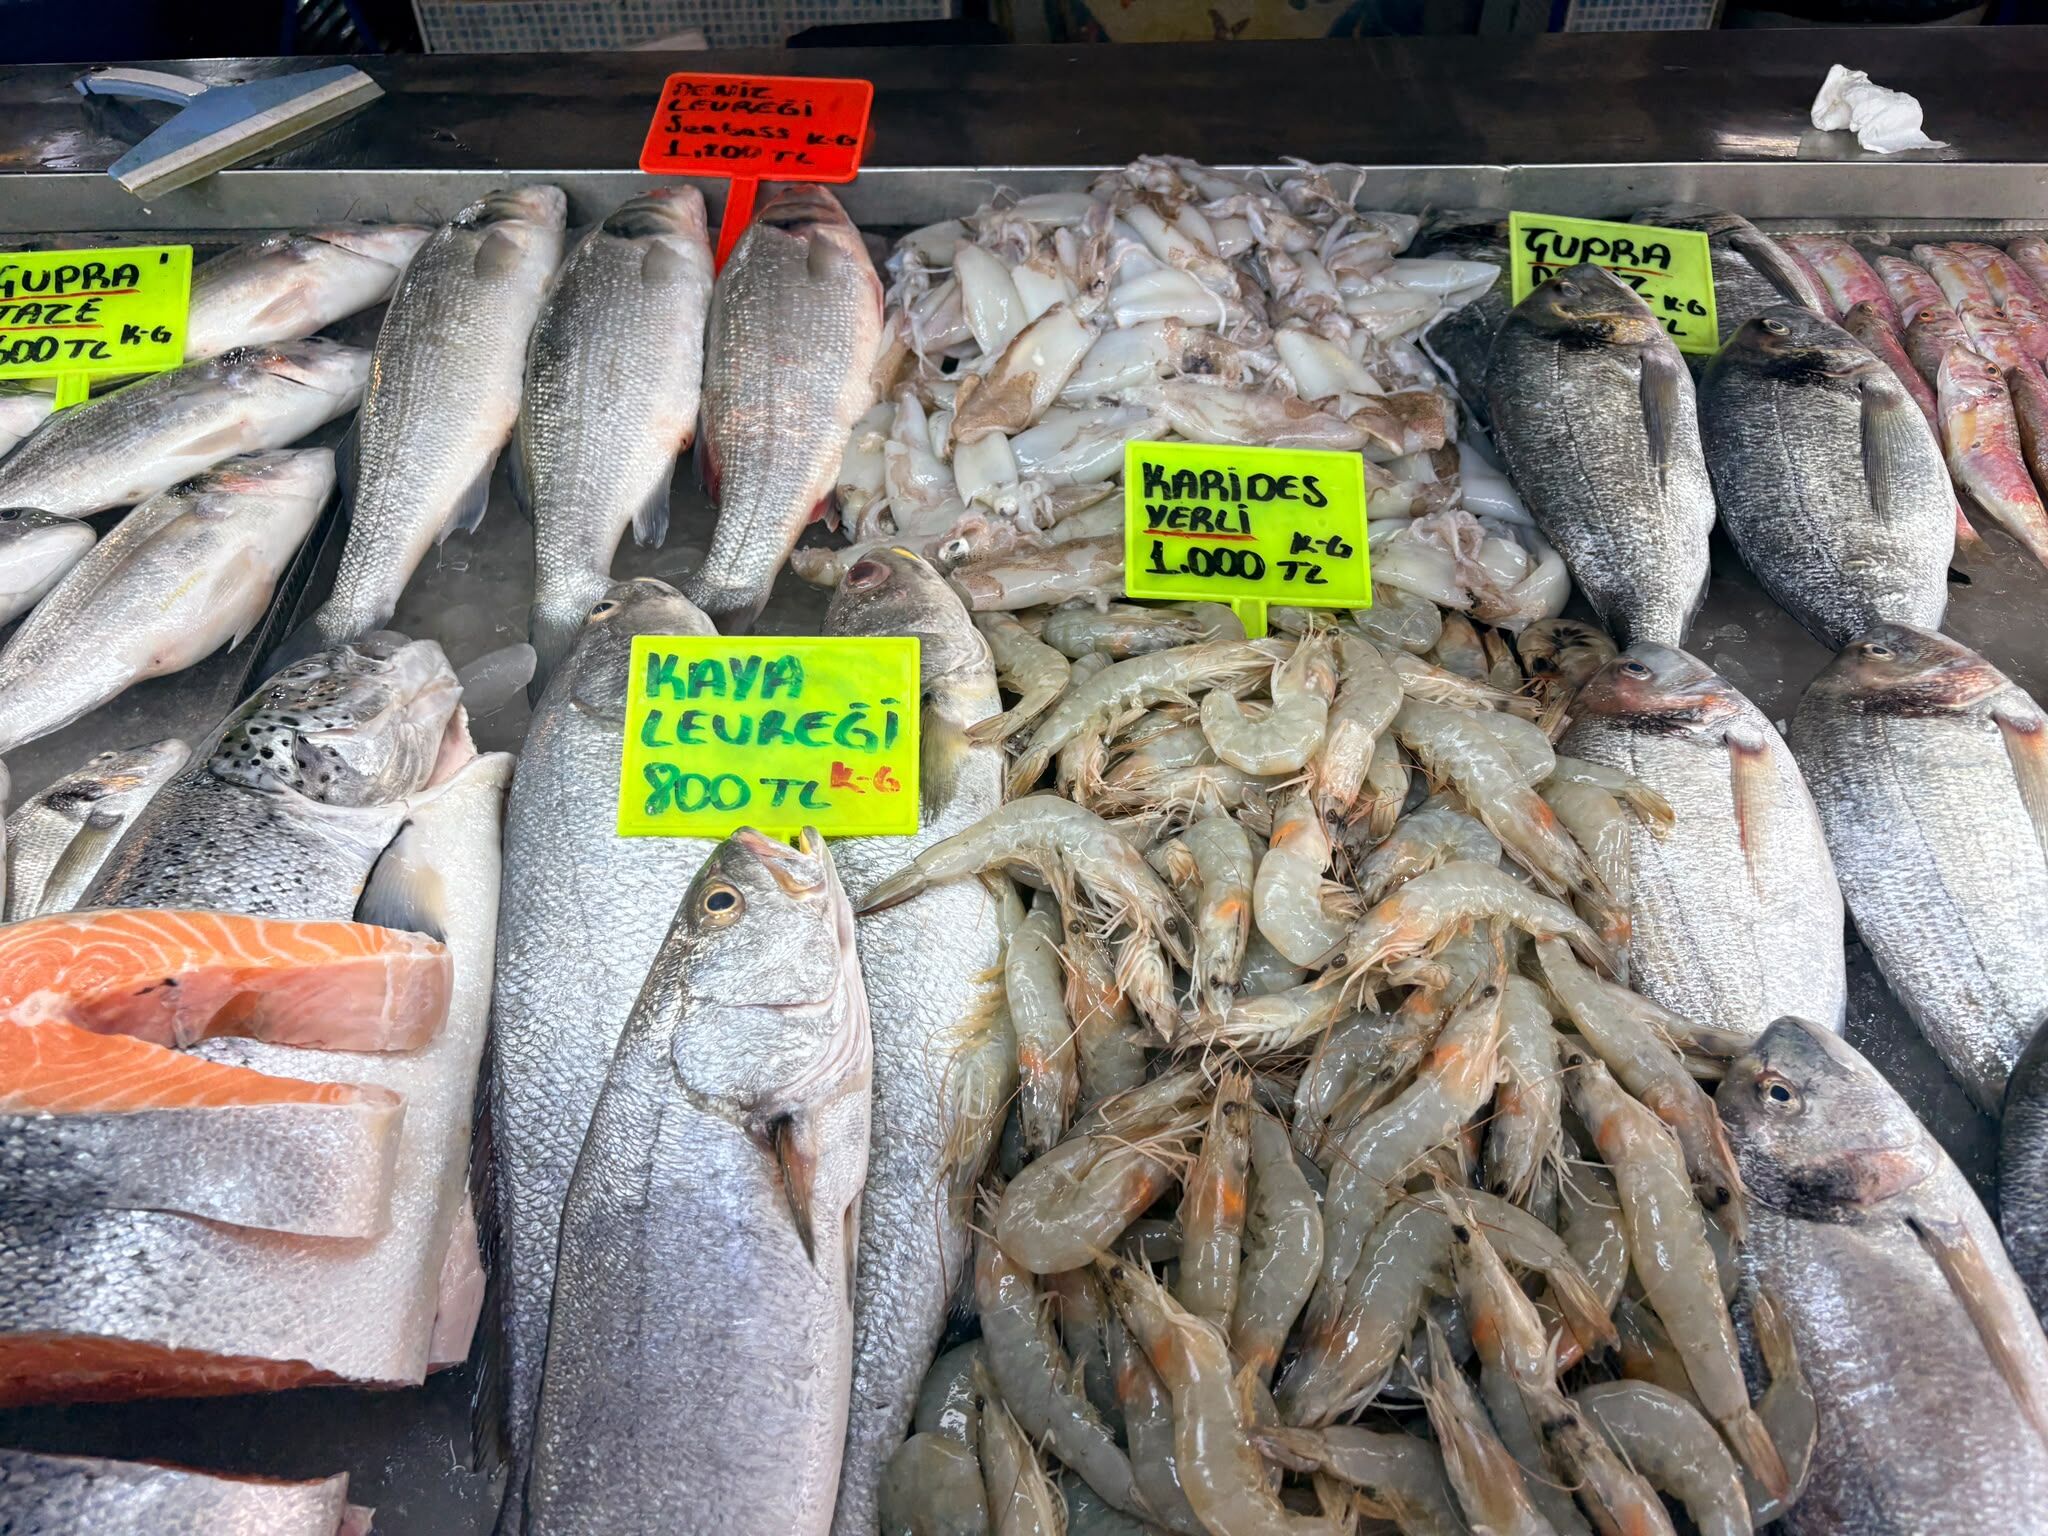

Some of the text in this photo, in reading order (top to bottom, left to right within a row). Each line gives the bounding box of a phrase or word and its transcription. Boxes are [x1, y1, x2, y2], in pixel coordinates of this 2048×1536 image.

[1663, 295, 1708, 317] K-G
[63, 339, 113, 360] TL
[120, 323, 173, 346] K-G
[1657, 316, 1688, 336] L
[1142, 462, 1328, 508] KARİDES
[1145, 503, 1251, 534] YERLİ
[1145, 540, 1328, 585] 1.000 TL
[1290, 532, 1353, 559] K-G
[646, 652, 805, 701] KAYA
[643, 762, 751, 817] 800
[760, 778, 832, 810] TL
